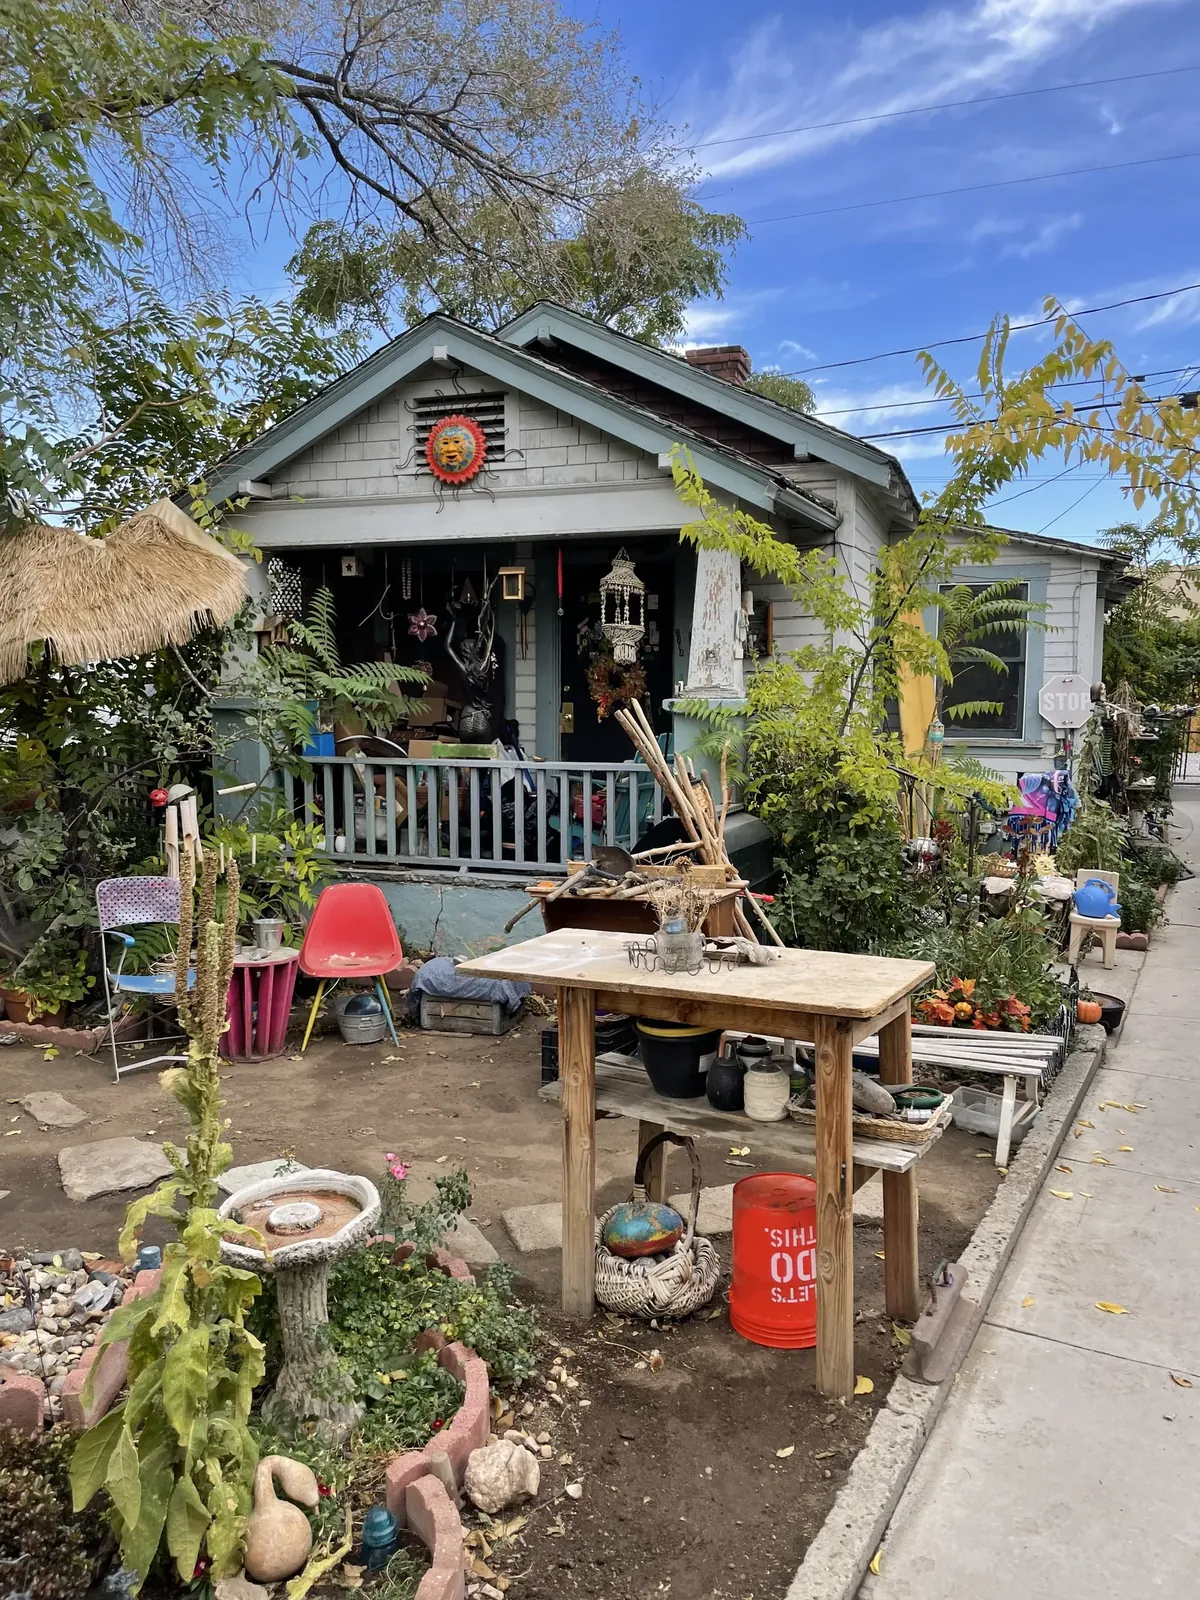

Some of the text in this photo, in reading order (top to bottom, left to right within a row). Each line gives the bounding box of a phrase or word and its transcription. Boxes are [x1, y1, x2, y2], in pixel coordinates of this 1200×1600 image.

[1043, 692, 1090, 711] STOP
[764, 1225, 816, 1248] THIS.
[770, 1248, 817, 1283] DO
